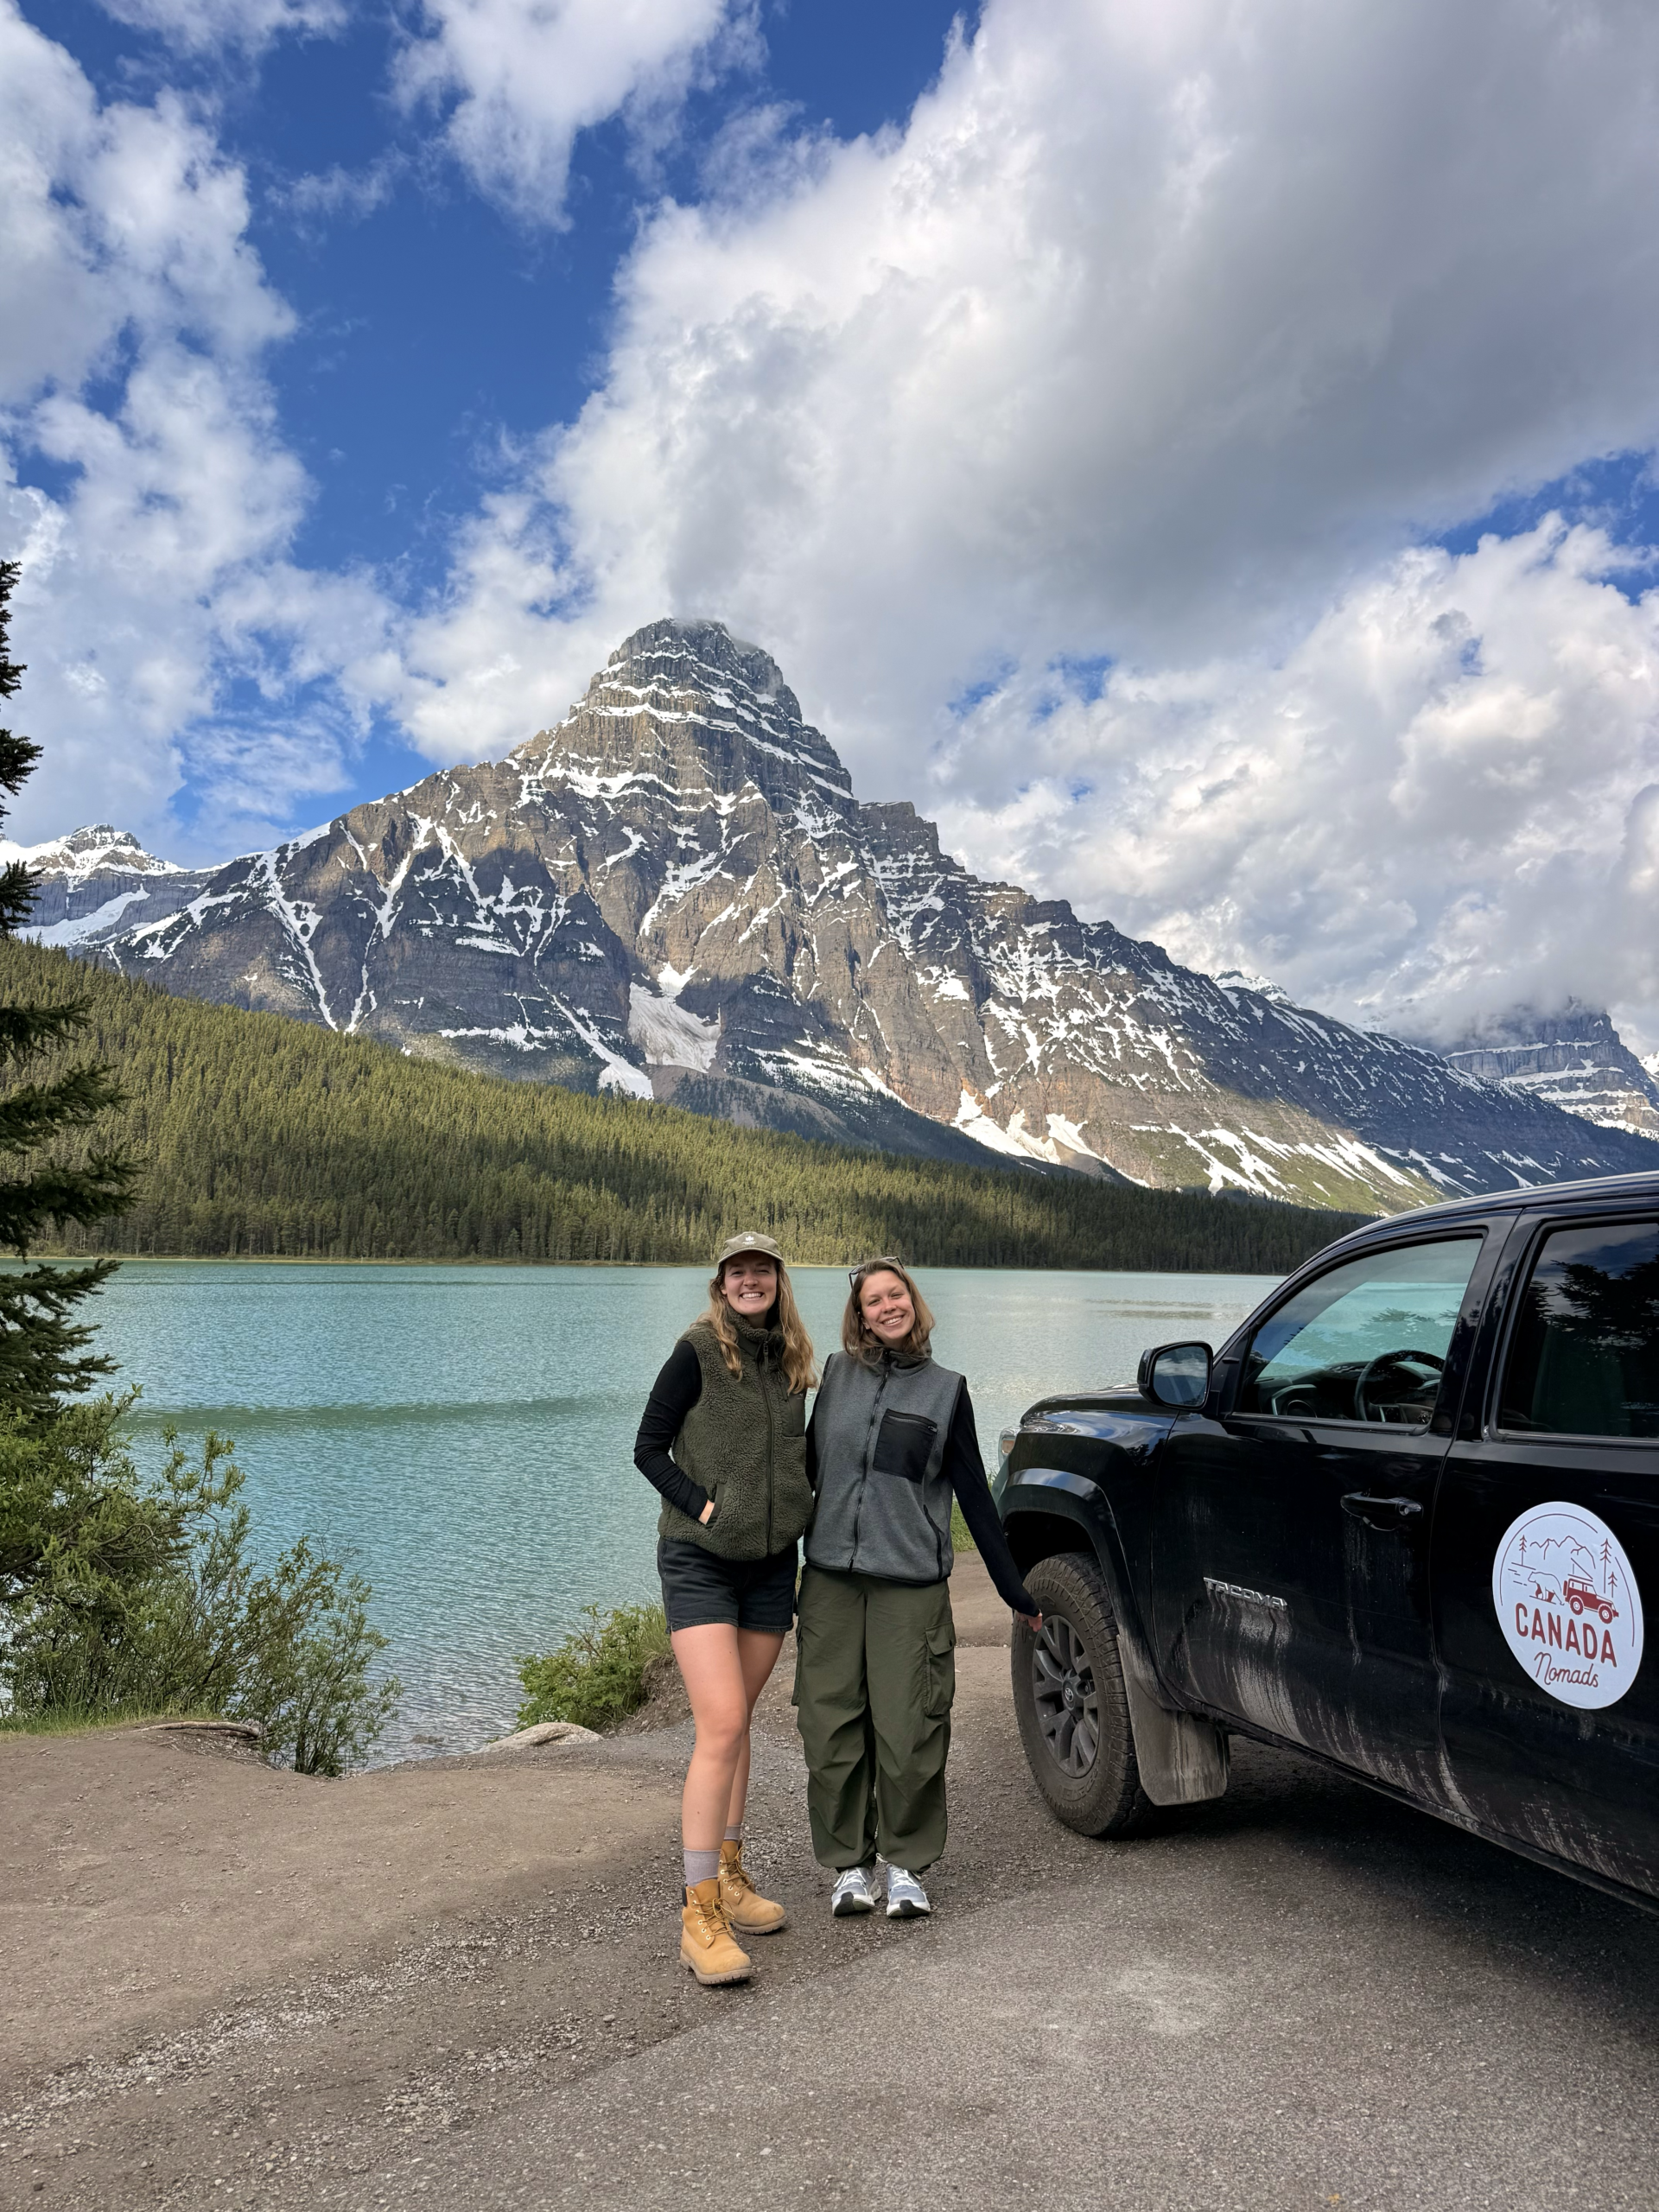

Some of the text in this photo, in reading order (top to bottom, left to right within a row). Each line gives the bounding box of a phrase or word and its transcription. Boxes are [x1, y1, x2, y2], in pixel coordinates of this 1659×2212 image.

[1203, 1577, 1287, 1611] TACOMA
[1516, 1603, 1617, 1668] CANADA
[1534, 1652, 1599, 1688] Nomads
